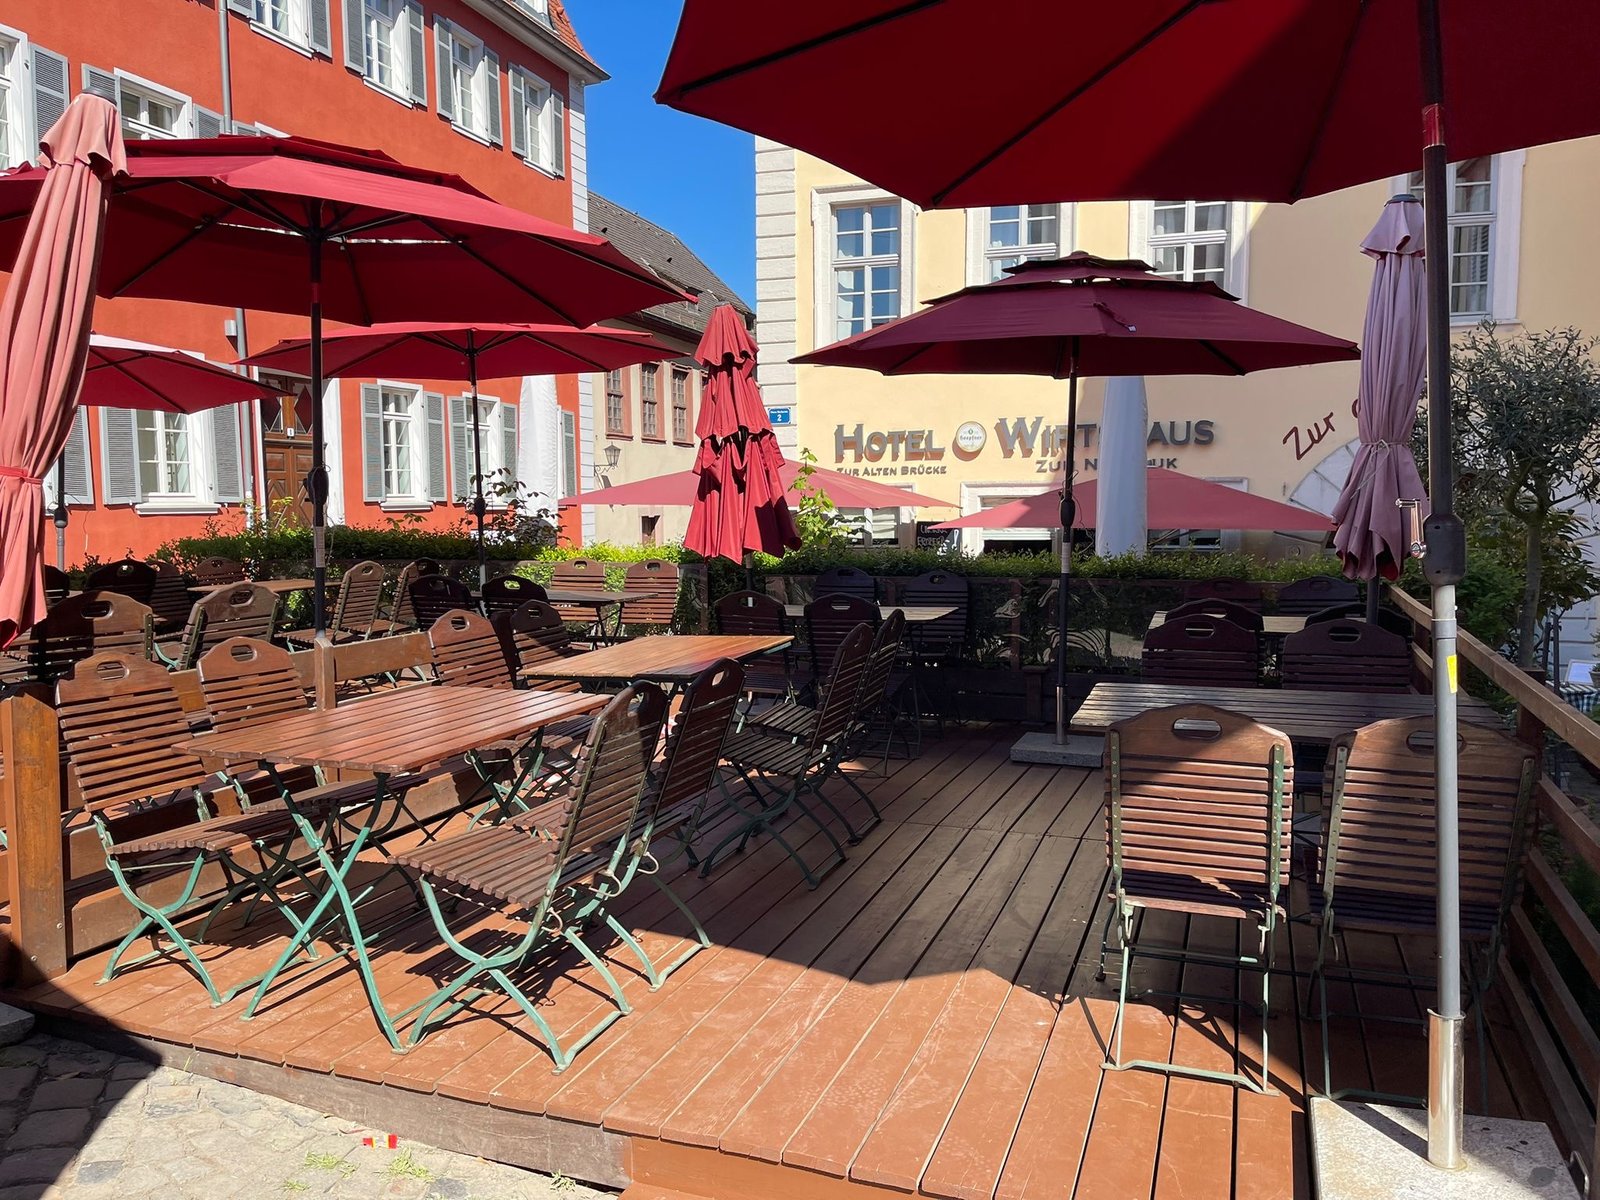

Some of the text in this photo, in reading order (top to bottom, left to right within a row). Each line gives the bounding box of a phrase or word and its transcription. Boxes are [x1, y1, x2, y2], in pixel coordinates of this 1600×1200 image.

[777, 414, 782, 422] 2
[834, 423, 946, 463] HOTEL
[994, 416, 1214, 458] WIRTAUS
[1282, 412, 1335, 460] Zur
[862, 466, 898, 477] ALTEN
[901, 464, 948, 476] BRÜCKE
[1036, 459, 1069, 474] ZU
